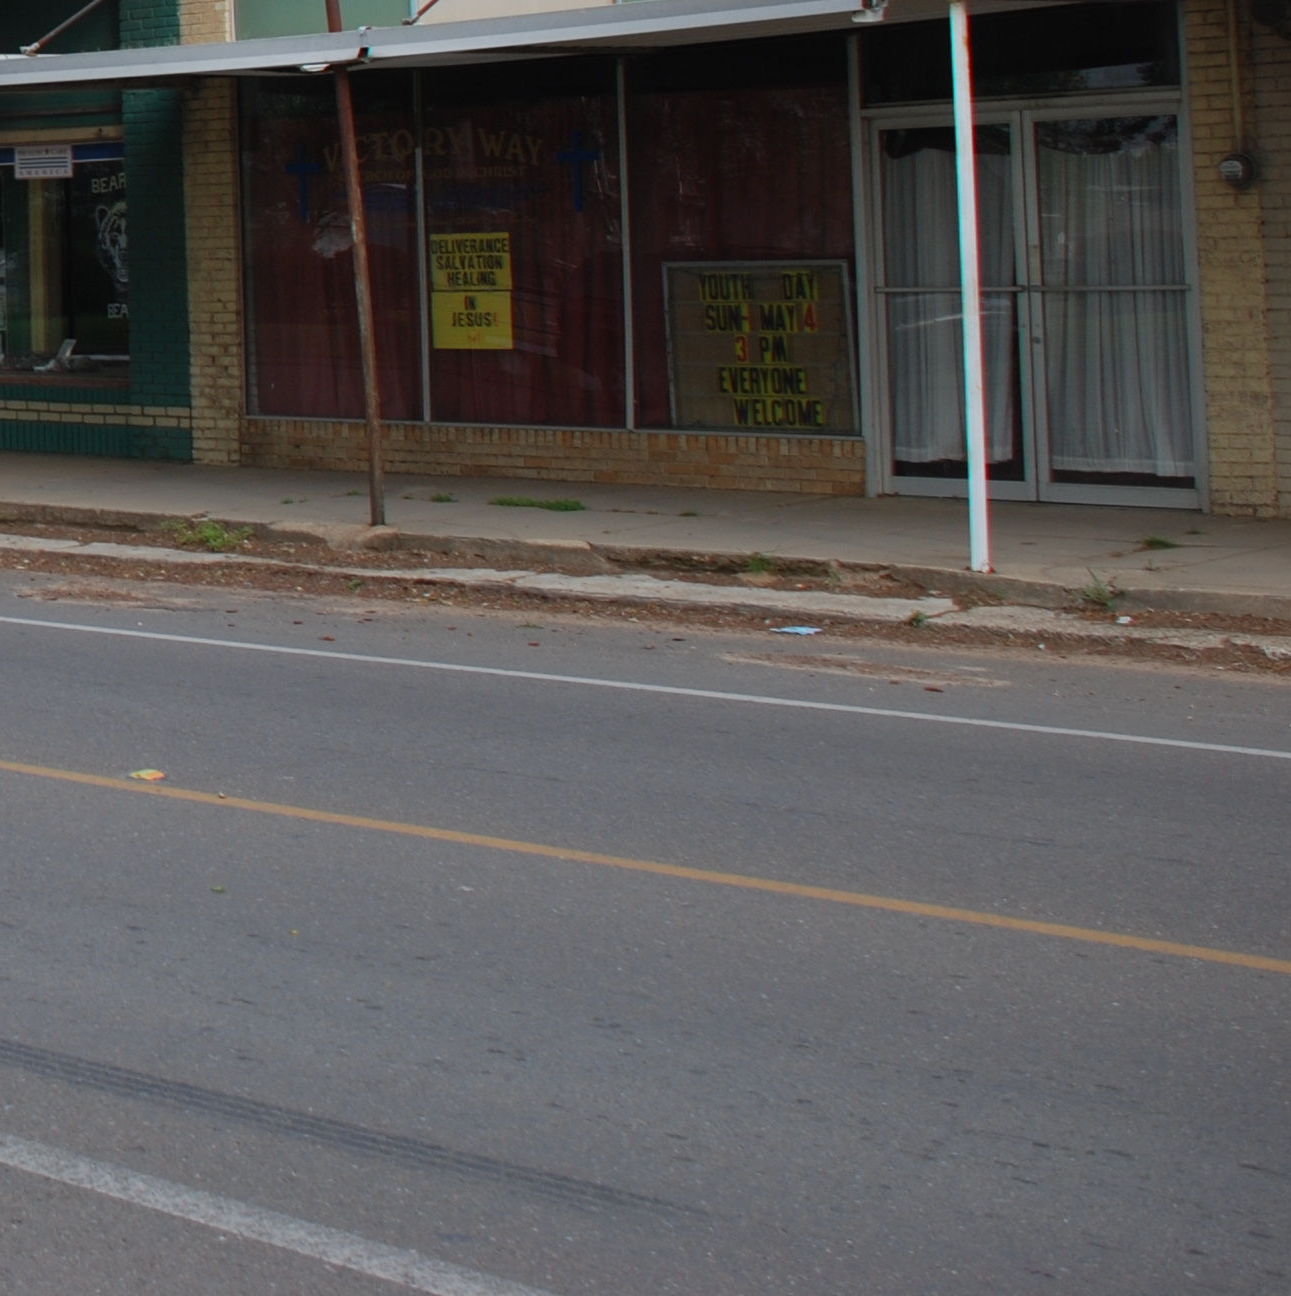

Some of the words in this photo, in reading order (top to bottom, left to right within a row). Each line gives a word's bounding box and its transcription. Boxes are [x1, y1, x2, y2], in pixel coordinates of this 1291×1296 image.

[323, 127, 467, 172] VCTORY
[478, 128, 543, 166] WAY
[475, 165, 527, 179] CHRIST
[430, 238, 509, 254] DELIVERANCE
[436, 254, 503, 270] SALVATION
[447, 270, 497, 287] HEALING
[699, 273, 752, 301] YOUTH
[781, 273, 816, 301] DAY
[464, 295, 477, 310] IN
[759, 304, 796, 331] MAY
[804, 304, 816, 331] 4
[735, 336, 747, 363] 3
[759, 336, 787, 363] PM
[718, 366, 806, 394] EVERYONE
[734, 399, 823, 427] WELCOME
